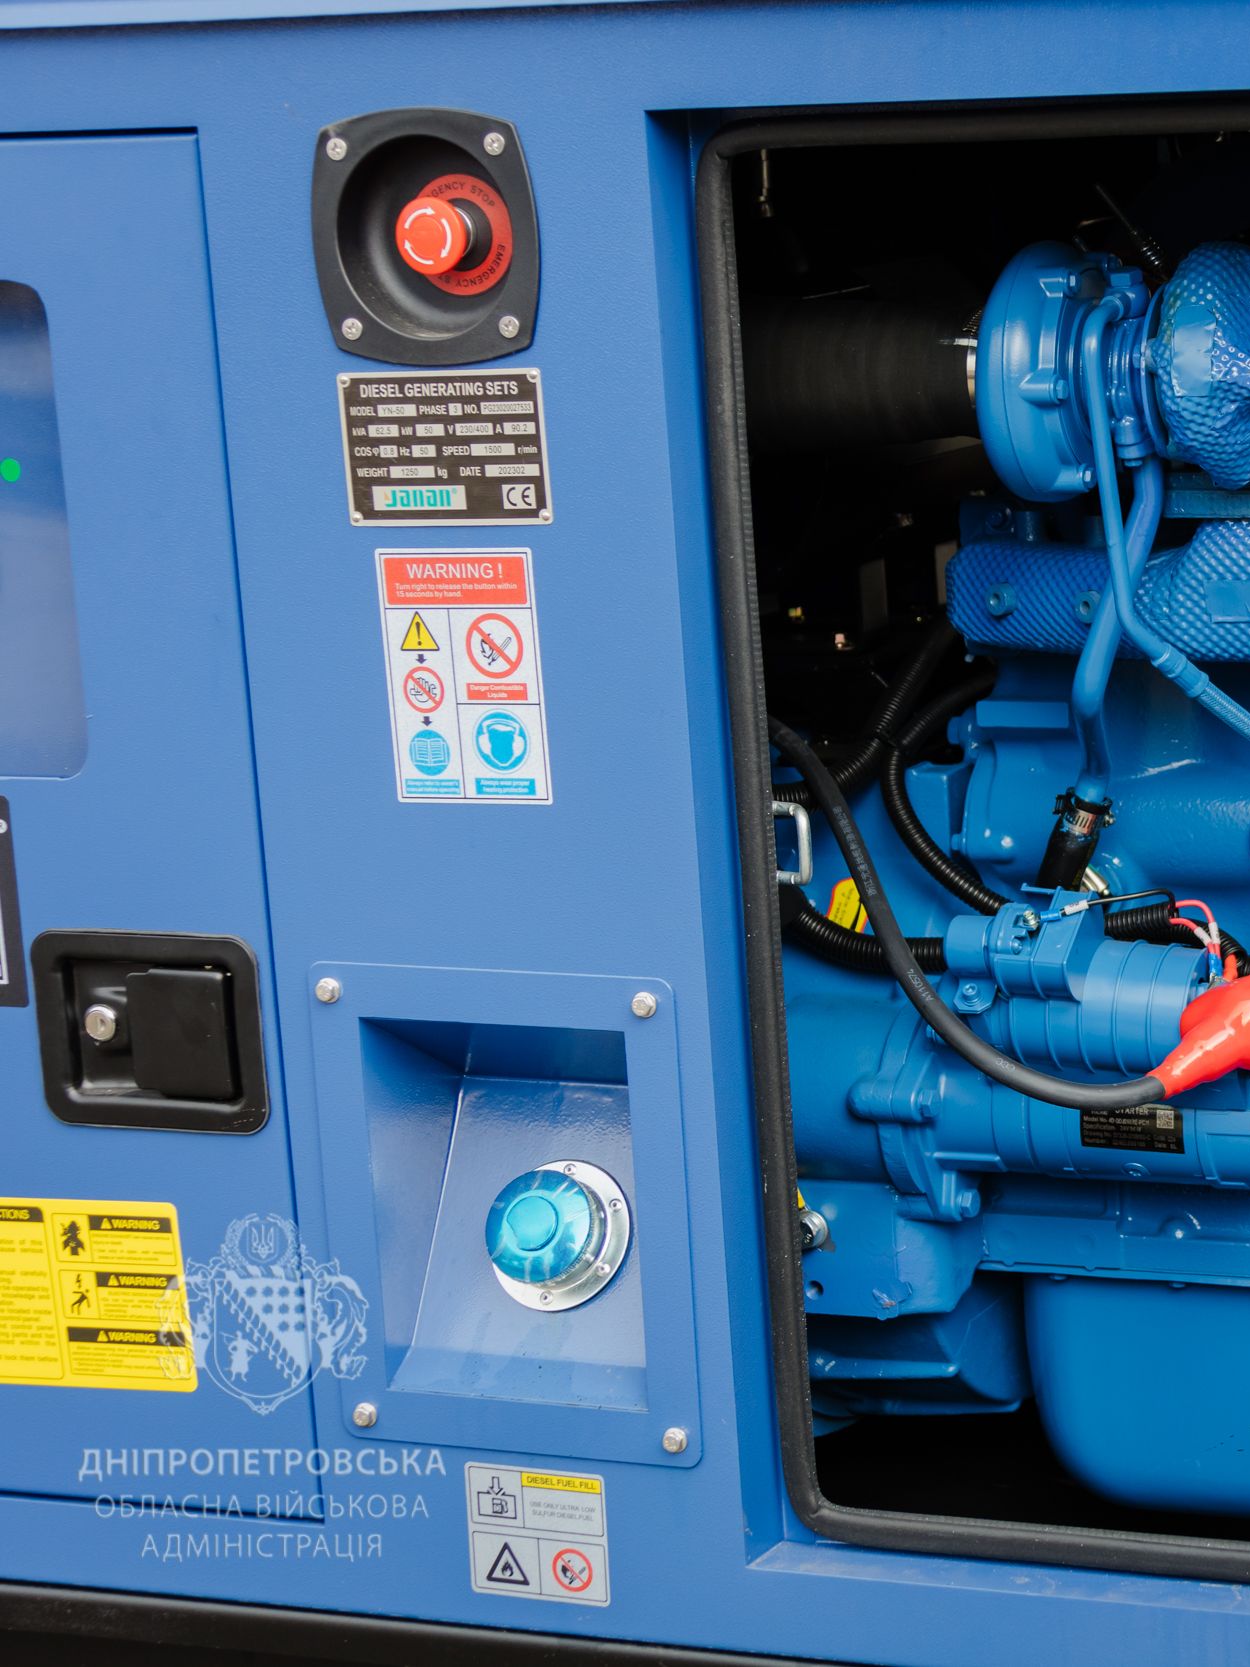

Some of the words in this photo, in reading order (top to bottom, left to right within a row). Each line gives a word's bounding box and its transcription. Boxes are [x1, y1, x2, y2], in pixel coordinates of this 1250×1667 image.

[470, 185, 496, 207] STOP
[455, 244, 506, 288] EMERGENCY
[360, 384, 404, 398] DIESEL
[404, 382, 484, 397] GENERATING
[485, 381, 518, 395] SETS
[349, 406, 376, 416] MODEL
[381, 406, 405, 415] YN-50
[418, 405, 447, 415] PHASE
[453, 405, 458, 413] 3
[463, 404, 480, 414] NO.
[352, 427, 367, 436] kVA
[375, 427, 391, 435] 62.5
[401, 426, 413, 436] kW
[424, 426, 433, 434] 50
[447, 425, 454, 435] V
[460, 424, 489, 434] 230/400
[495, 423, 503, 434] A
[511, 424, 527, 432] 90.2
[383, 447, 394, 455] 0.8
[399, 446, 411, 456] Hz
[420, 447, 428, 455] 50
[442, 446, 470, 456] SPEED
[484, 446, 502, 454] 1500
[517, 445, 538, 455] r/min
[356, 467, 388, 478] WEIGHT
[401, 468, 418, 476] 1250
[437, 467, 448, 479] kg
[459, 466, 482, 476] DATE
[498, 466, 525, 475] 202302
[506, 486, 533, 507] CE
[405, 563, 494, 579] WARNING
[411, 583, 427, 591] right
[434, 591, 443, 599] by
[111, 1219, 160, 1230] WARNING
[118, 1275, 168, 1287] WARNING
[107, 1331, 157, 1343] WARNING
[527, 1476, 555, 1486] DIESEL
[557, 1479, 578, 1488] FUEL
[579, 1481, 596, 1490] FILL
